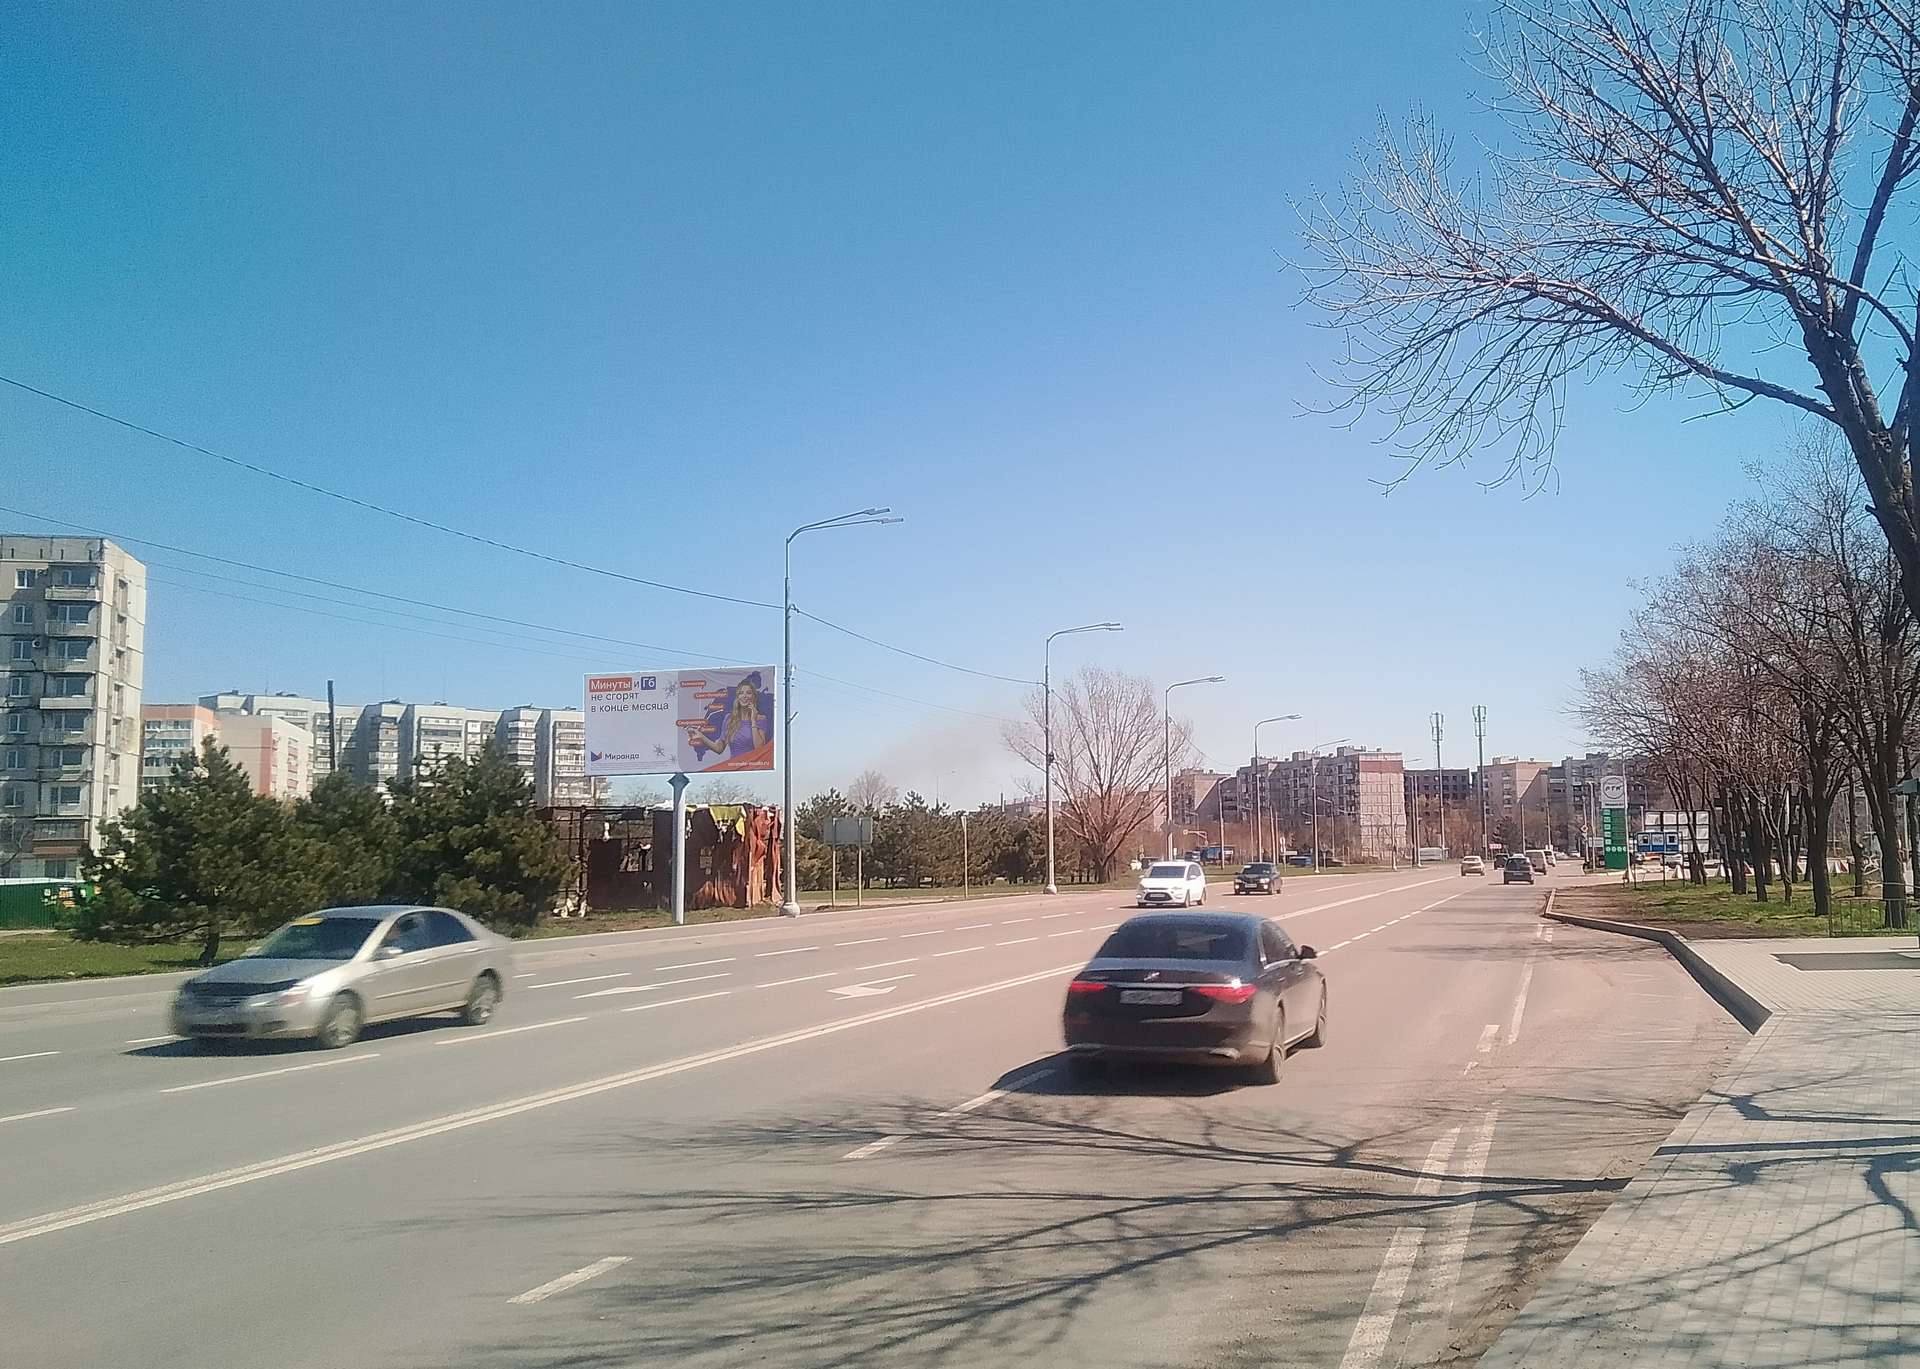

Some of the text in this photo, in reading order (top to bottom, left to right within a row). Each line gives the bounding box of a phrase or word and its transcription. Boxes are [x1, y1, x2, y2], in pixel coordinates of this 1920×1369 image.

[591, 680, 631, 691] Минуты
[642, 678, 655, 688] Гб
[591, 692, 640, 702] не сгорят
[591, 702, 669, 713] в конце месяца
